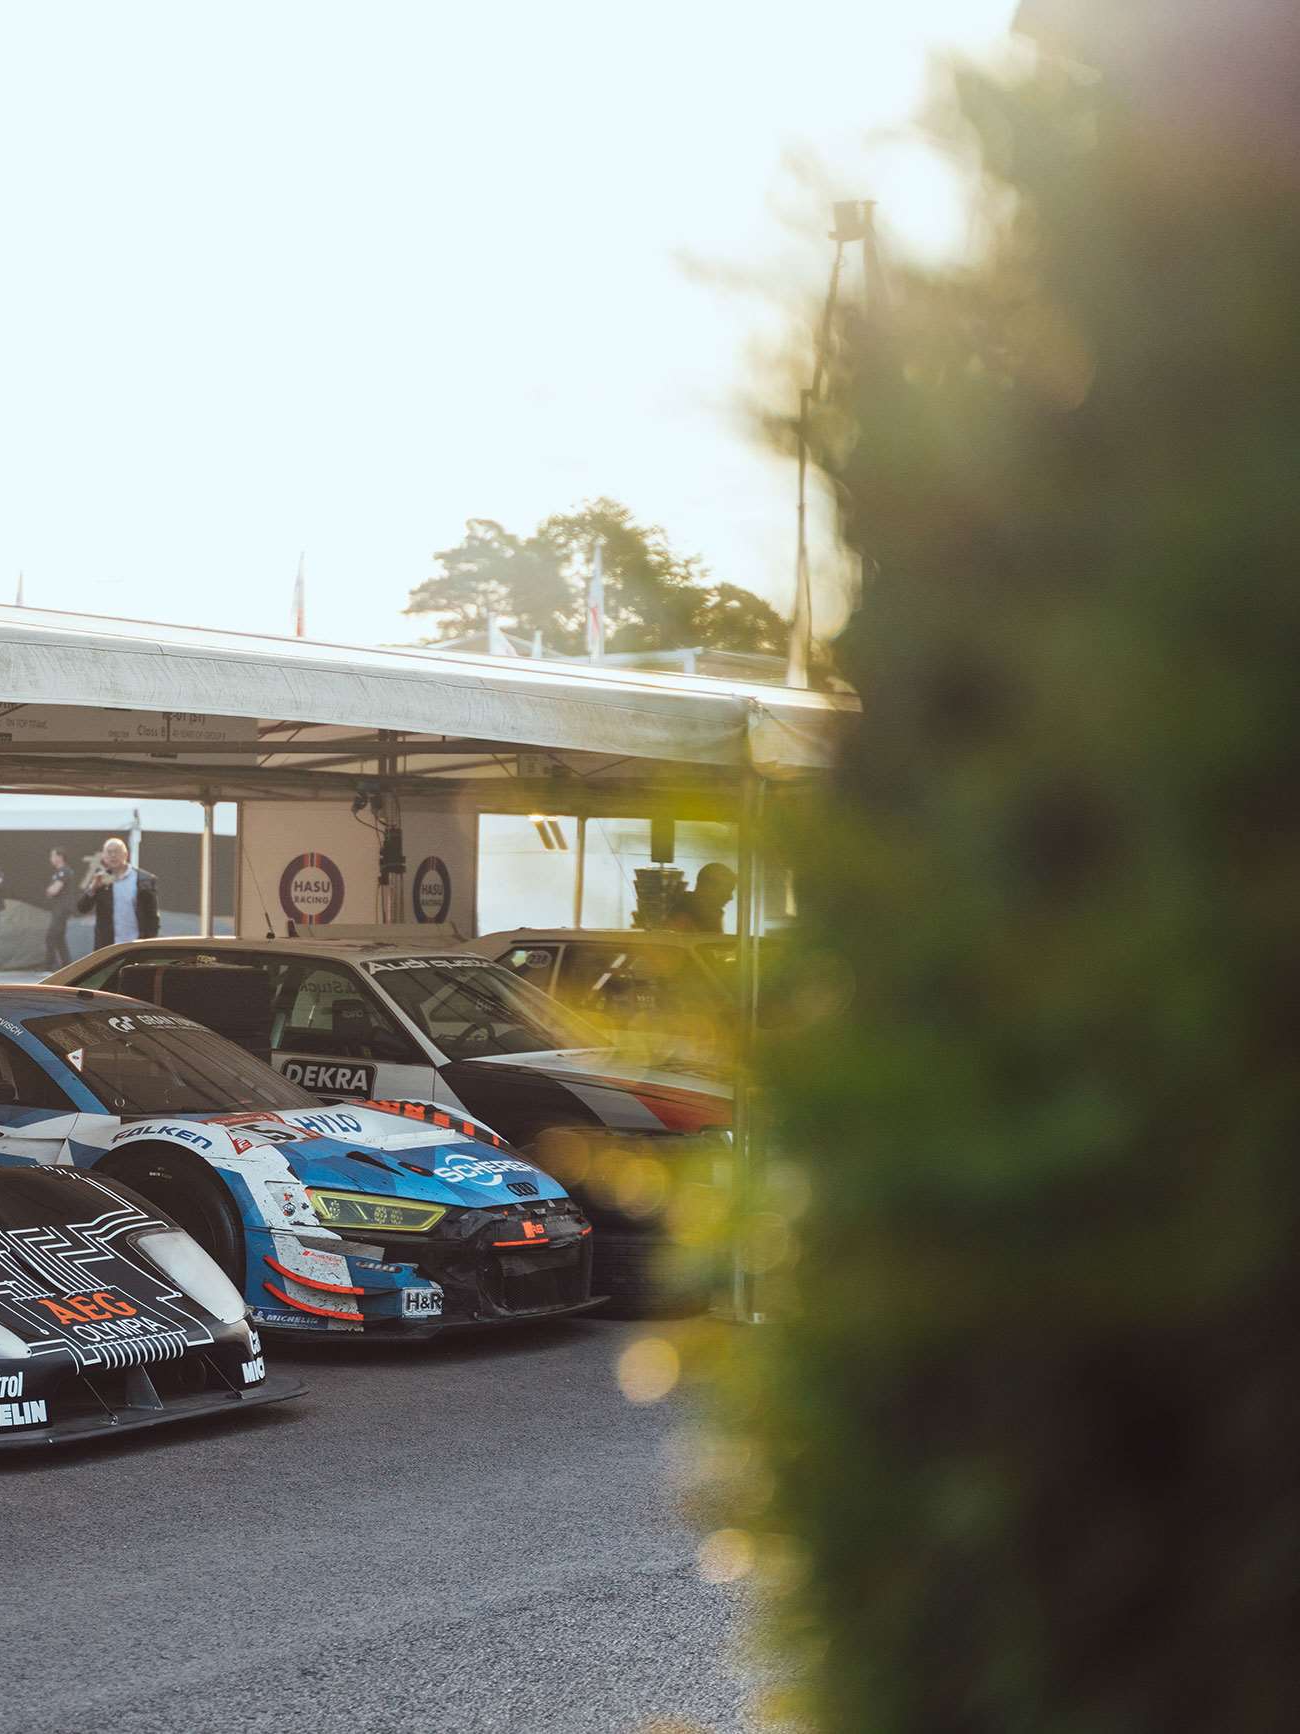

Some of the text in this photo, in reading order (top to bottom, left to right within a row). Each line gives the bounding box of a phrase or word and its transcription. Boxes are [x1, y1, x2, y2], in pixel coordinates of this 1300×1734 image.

[294, 880, 331, 894] HASU
[422, 884, 443, 896] HASU
[294, 896, 330, 905] RACING
[285, 1064, 368, 1091] DEKRA
[294, 1113, 363, 1134] HYLO
[111, 1125, 213, 1150] FALKEN
[433, 1159, 540, 1183] SCHERER
[38, 1292, 138, 1325] AEG
[407, 1292, 442, 1311] H&R
[71, 1317, 169, 1342] OLYMPIA
[266, 1314, 319, 1325] MICHELIN
